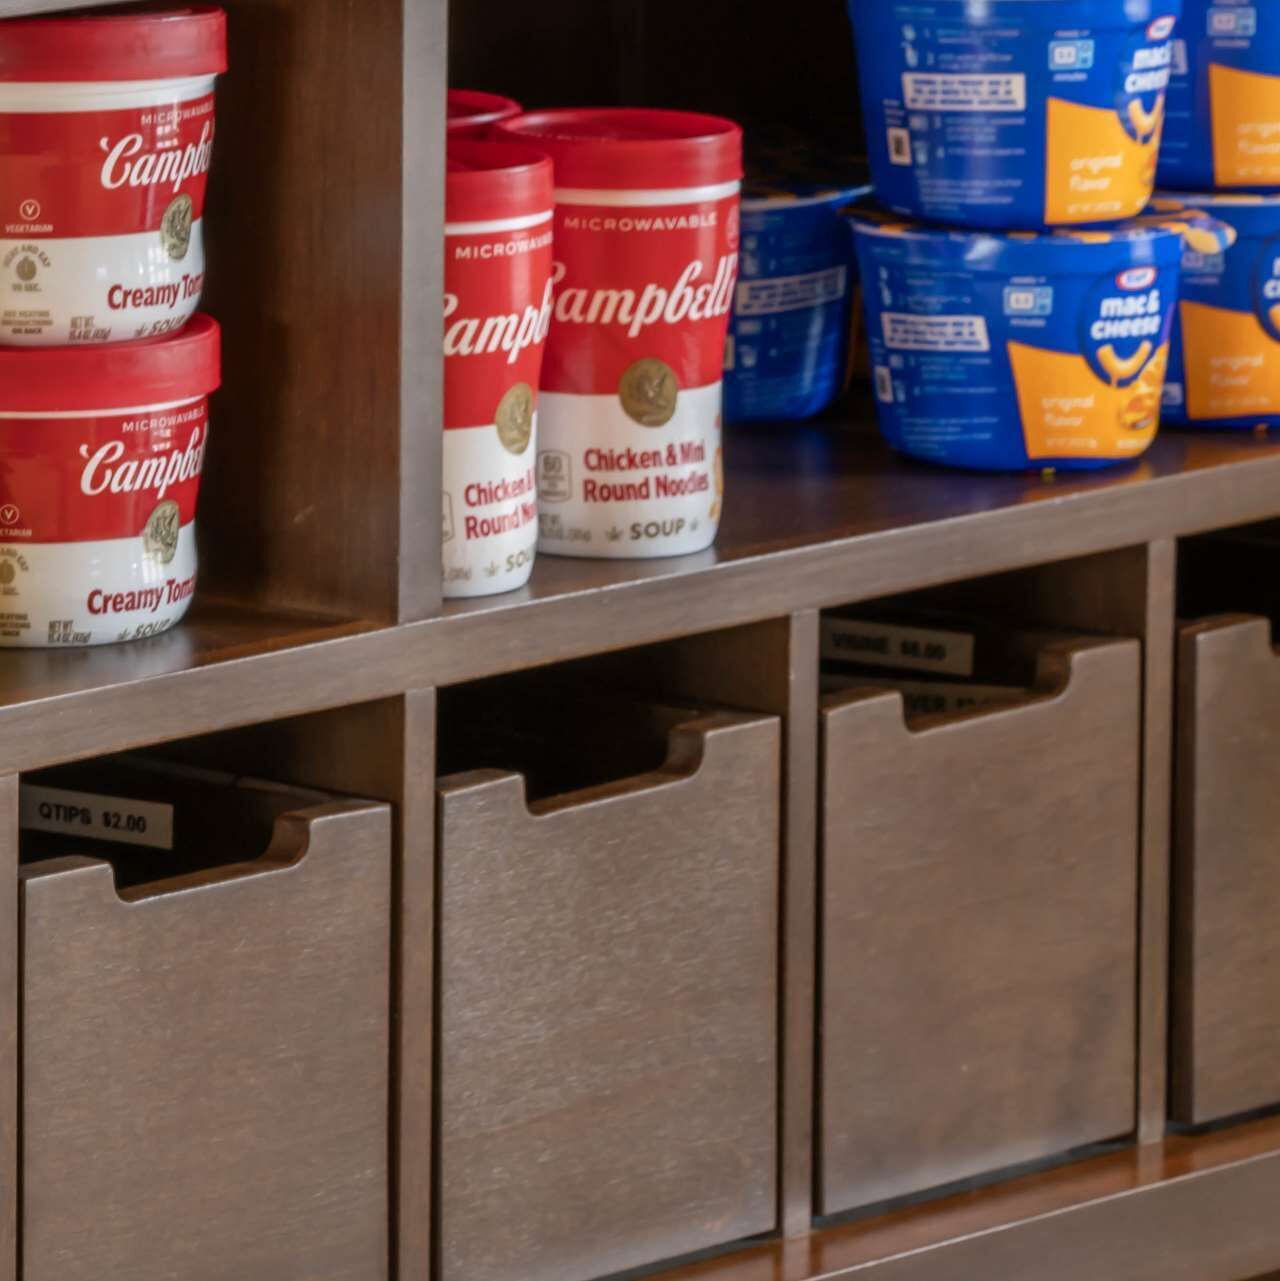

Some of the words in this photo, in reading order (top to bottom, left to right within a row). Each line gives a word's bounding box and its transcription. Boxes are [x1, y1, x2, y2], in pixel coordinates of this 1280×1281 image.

[564, 213, 717, 232] MICROWAVABLE
[107, 280, 180, 314] Creamy
[583, 446, 661, 473] Chicken
[666, 446, 679, 466] &
[464, 479, 522, 508] Chicken
[583, 477, 652, 504] Round
[655, 471, 710, 501] Noodles
[464, 506, 520, 541] Round
[630, 519, 687, 541] SOUP
[87, 587, 164, 616] Creamy
[38, 802, 92, 825] QTIPS
